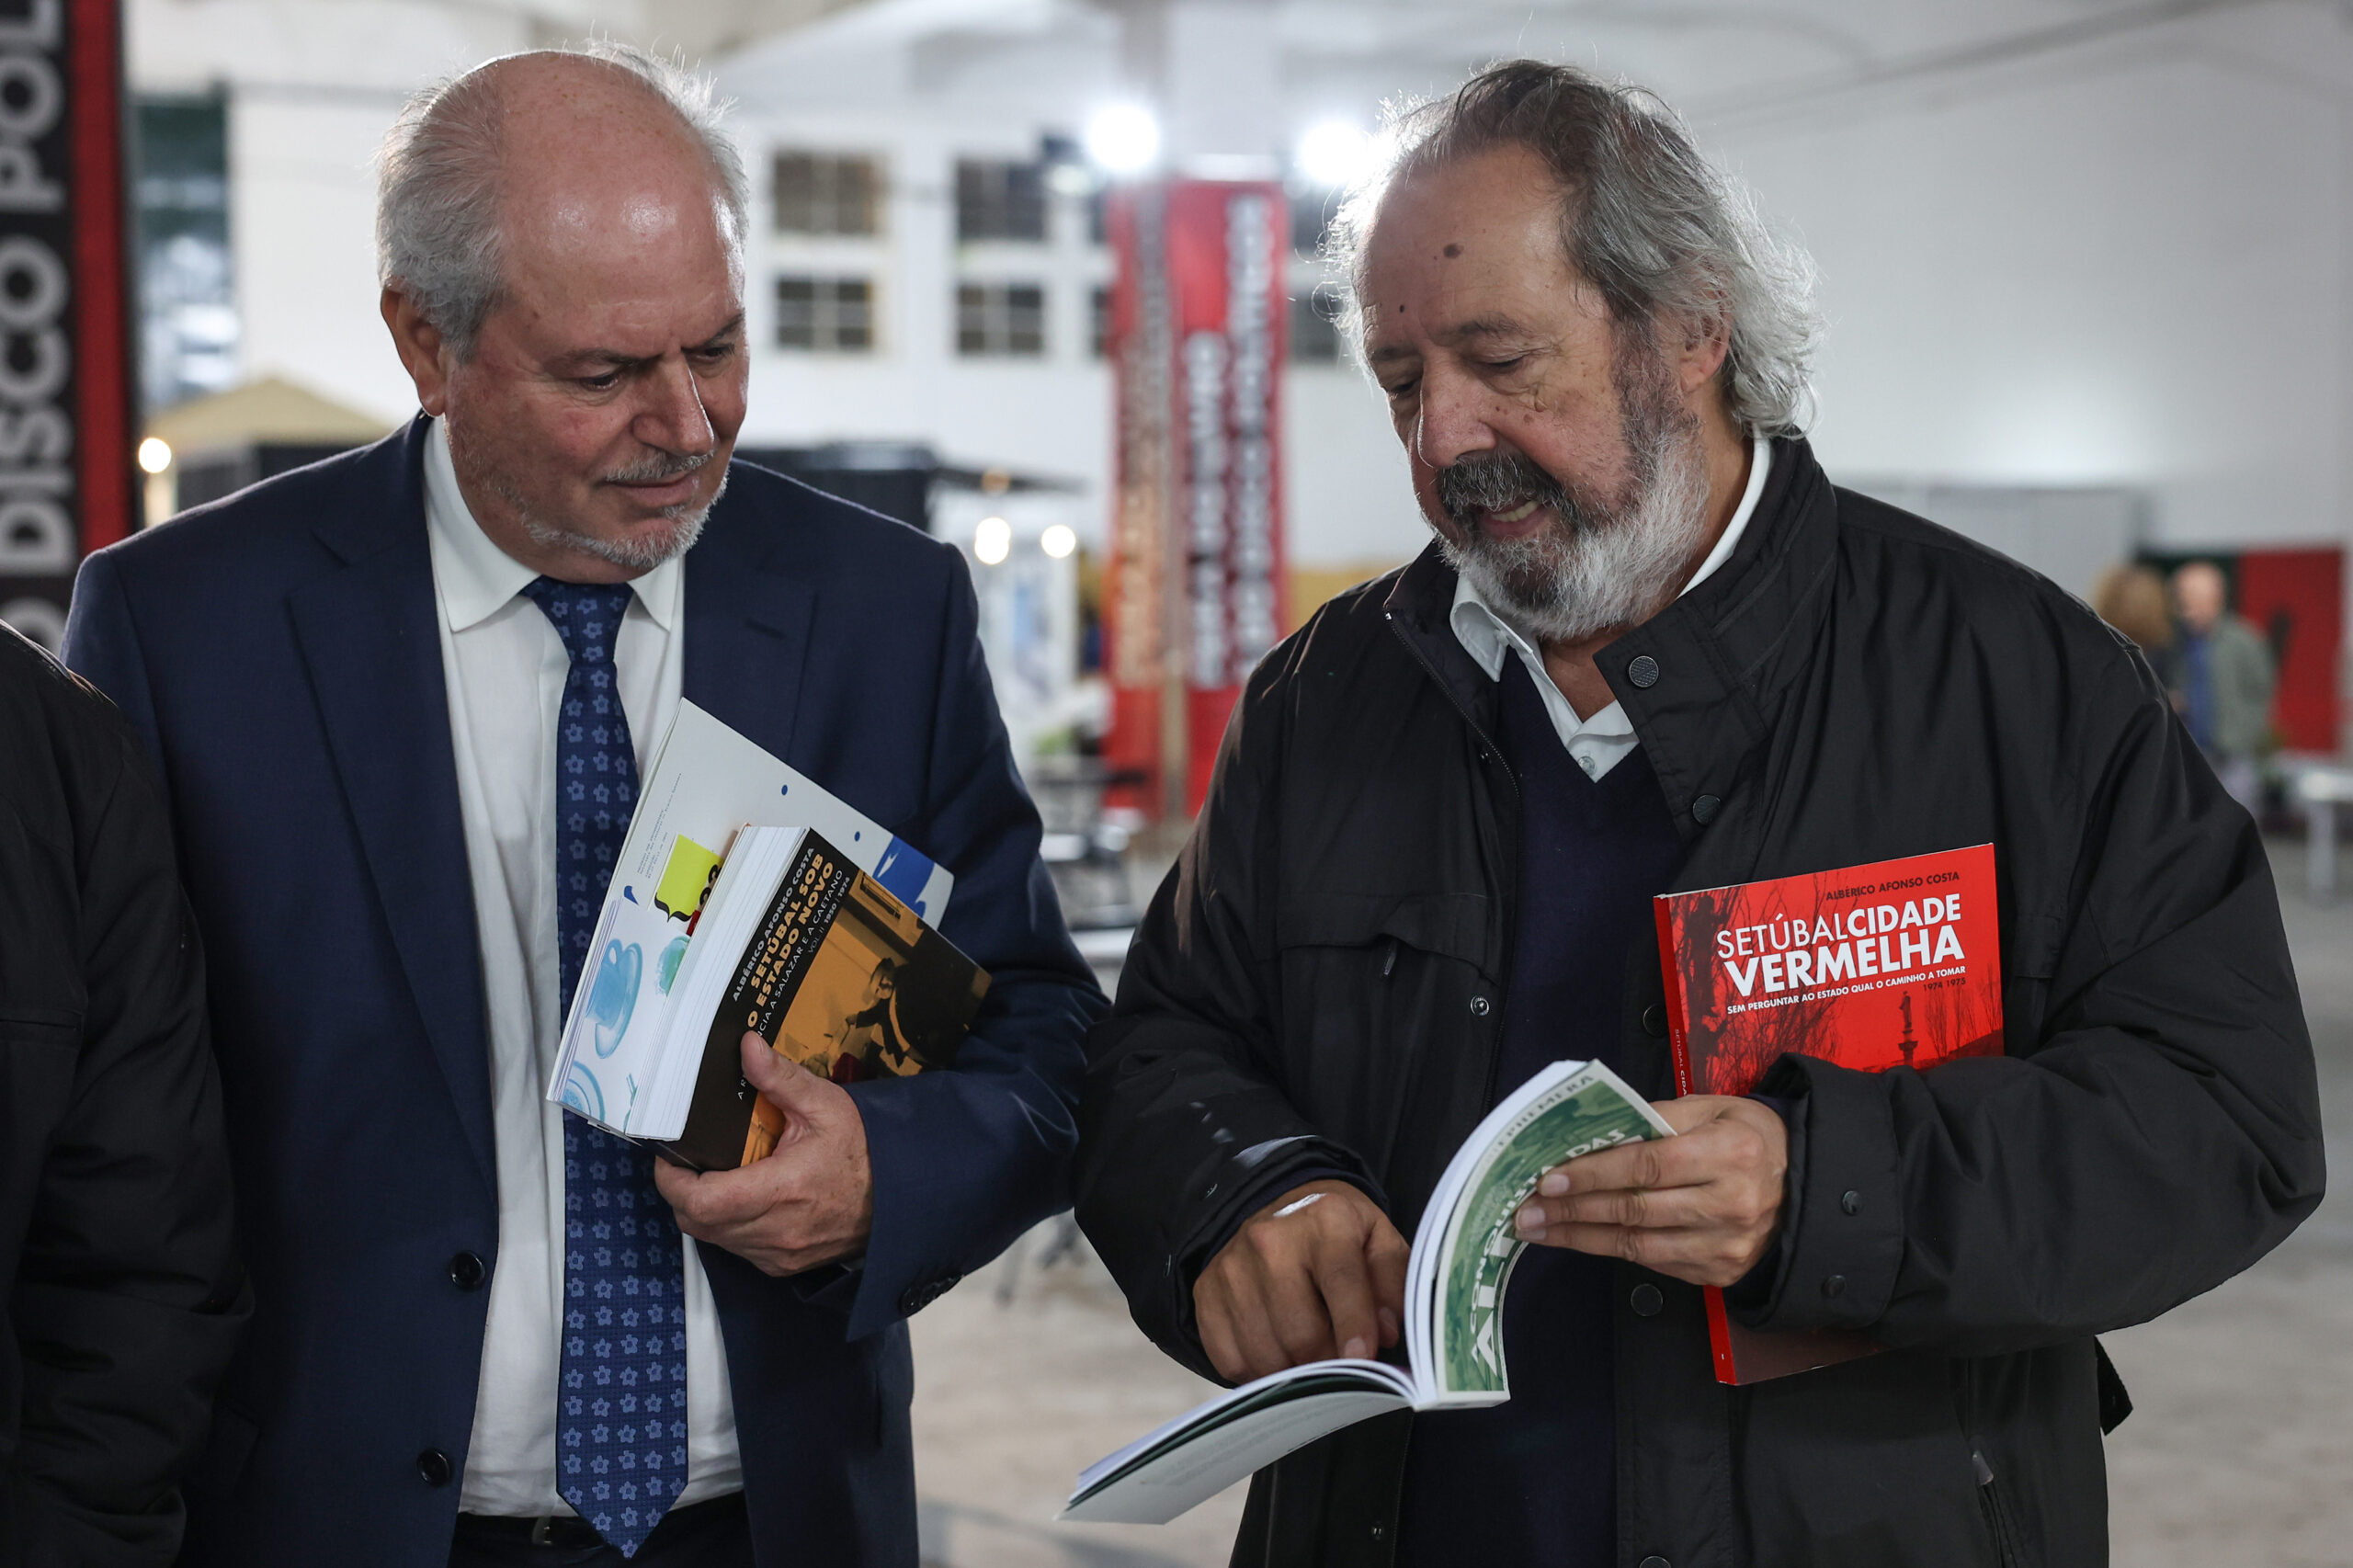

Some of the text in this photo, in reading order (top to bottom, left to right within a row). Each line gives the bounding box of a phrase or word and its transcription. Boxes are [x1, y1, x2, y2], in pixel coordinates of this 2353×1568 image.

[0, 234, 74, 576] DISCO
[750, 900, 801, 989] SETÚBAL
[799, 854, 824, 896] SOB
[824, 903, 837, 924] 1950
[837, 876, 850, 897] 1974
[1825, 871, 1960, 901] ALBÉRICO AFONSO COSTA
[733, 939, 765, 1002] ALBÉRICO
[764, 887, 793, 939] AFONSO
[792, 847, 814, 885] COSTA
[747, 1010, 758, 1028] O
[756, 927, 800, 1007] ESTADO
[798, 862, 834, 925] NOVO
[770, 1001, 778, 1009] A
[775, 947, 804, 998] SALAZAR
[801, 936, 809, 945] E
[807, 926, 815, 936] A
[813, 869, 843, 925] CAETANO
[1723, 924, 1965, 997] VERMELHA
[1727, 966, 1966, 1015] SEM PERGUNTAR AO ESTADO QUAL O CAMINHO A TOMAR
[1923, 977, 1967, 991] 1974 1975
[1565, 1129, 1626, 1158] DAS
